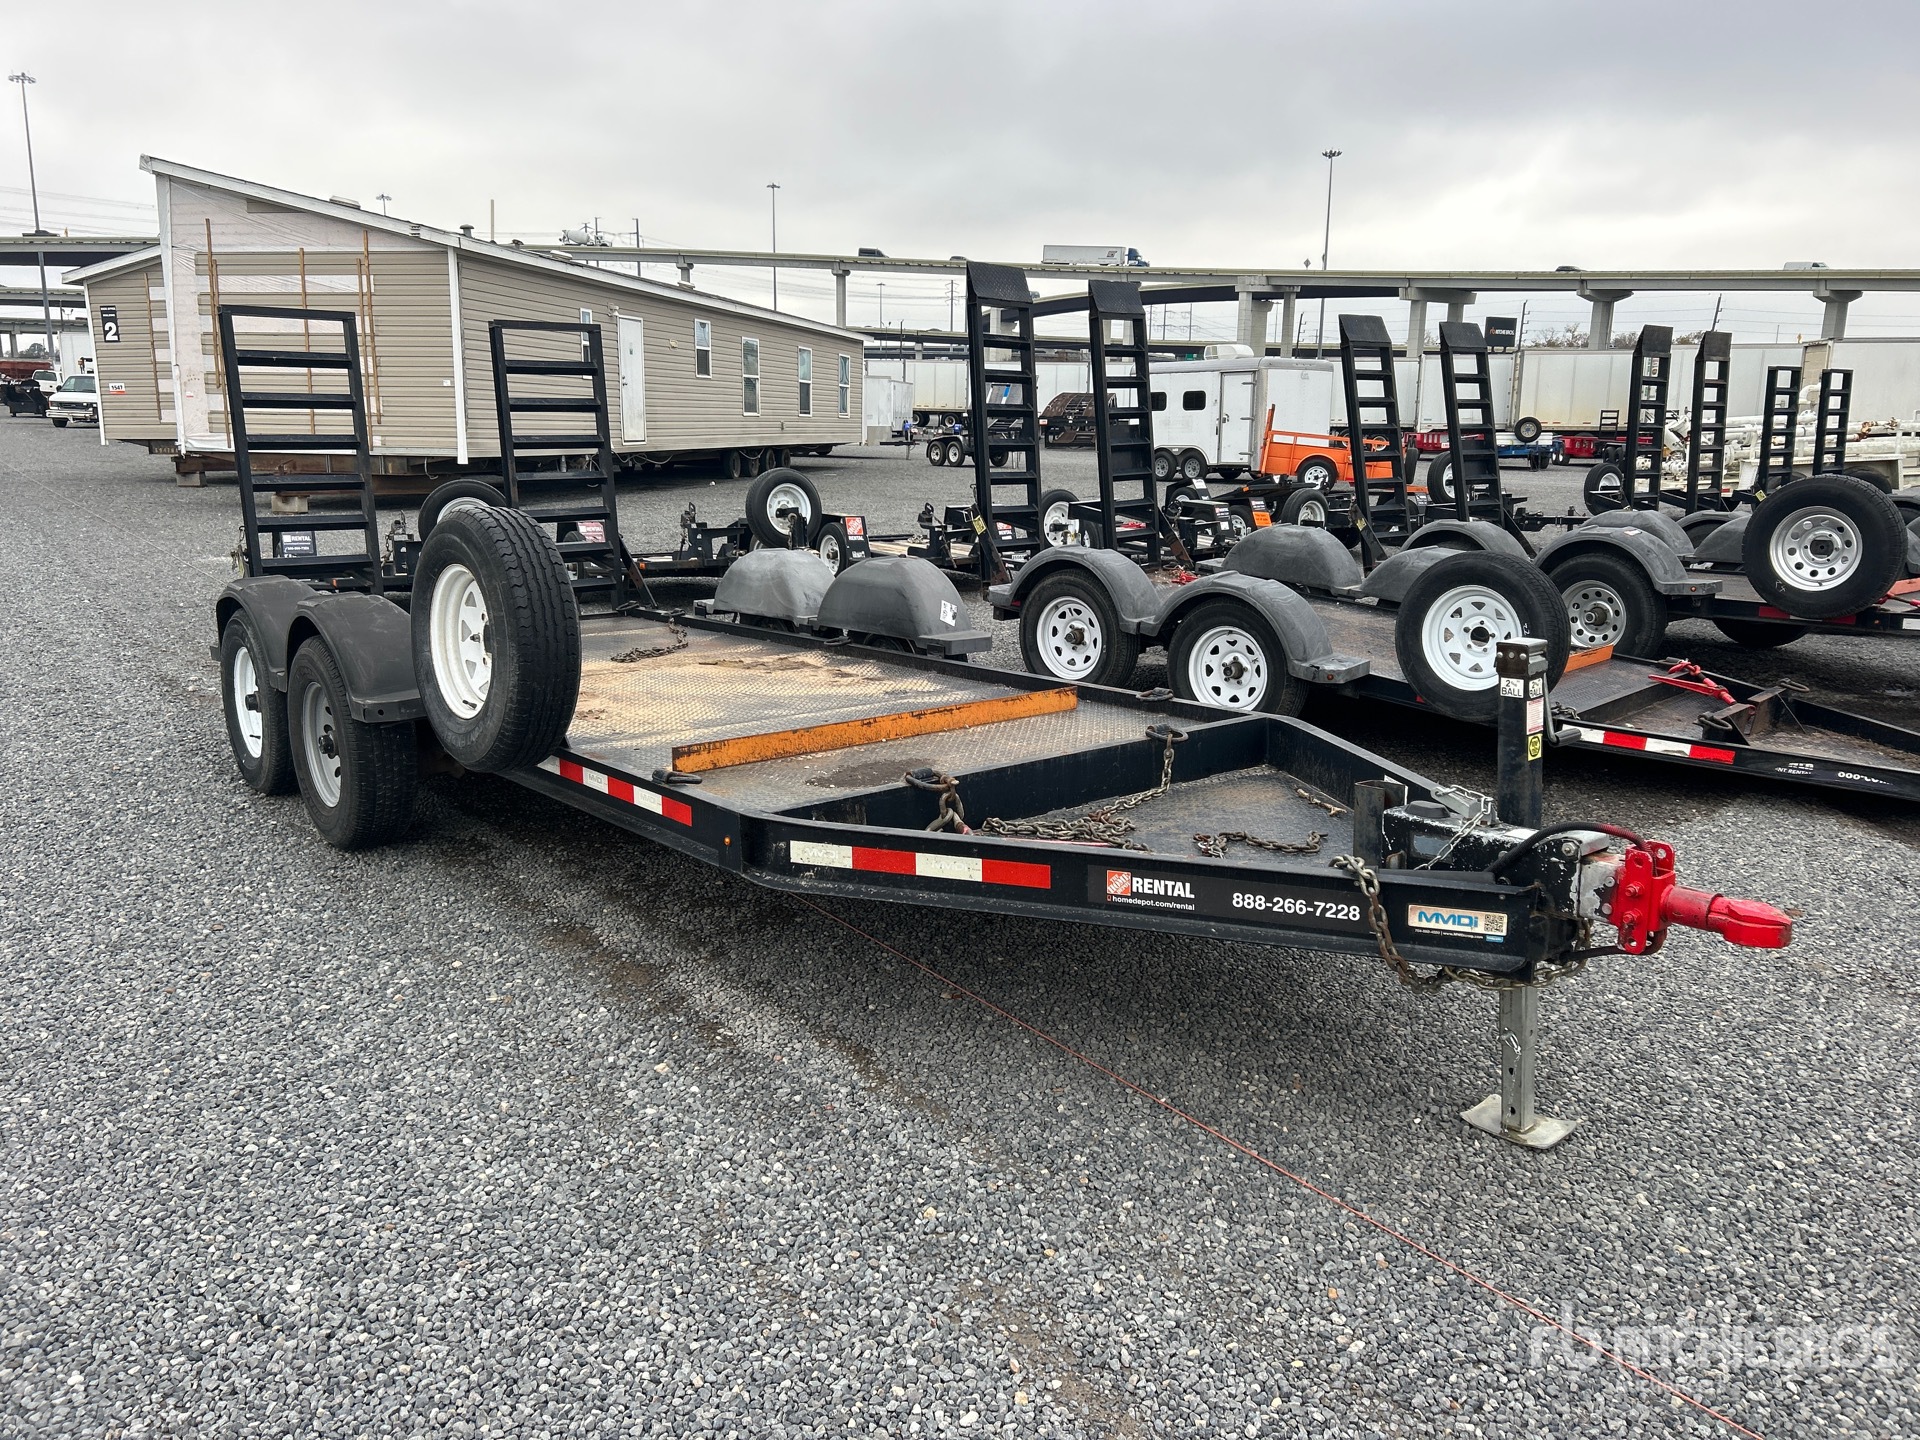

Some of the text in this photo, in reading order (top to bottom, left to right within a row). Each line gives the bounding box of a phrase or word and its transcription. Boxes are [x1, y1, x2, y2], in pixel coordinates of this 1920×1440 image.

[104, 321, 118, 341] 2
[1501, 686, 1523, 697] BALL
[1132, 877, 1195, 899] RENTAL
[1112, 895, 1195, 911] homedepot.com/rental
[1232, 892, 1360, 921] 888-266-7228
